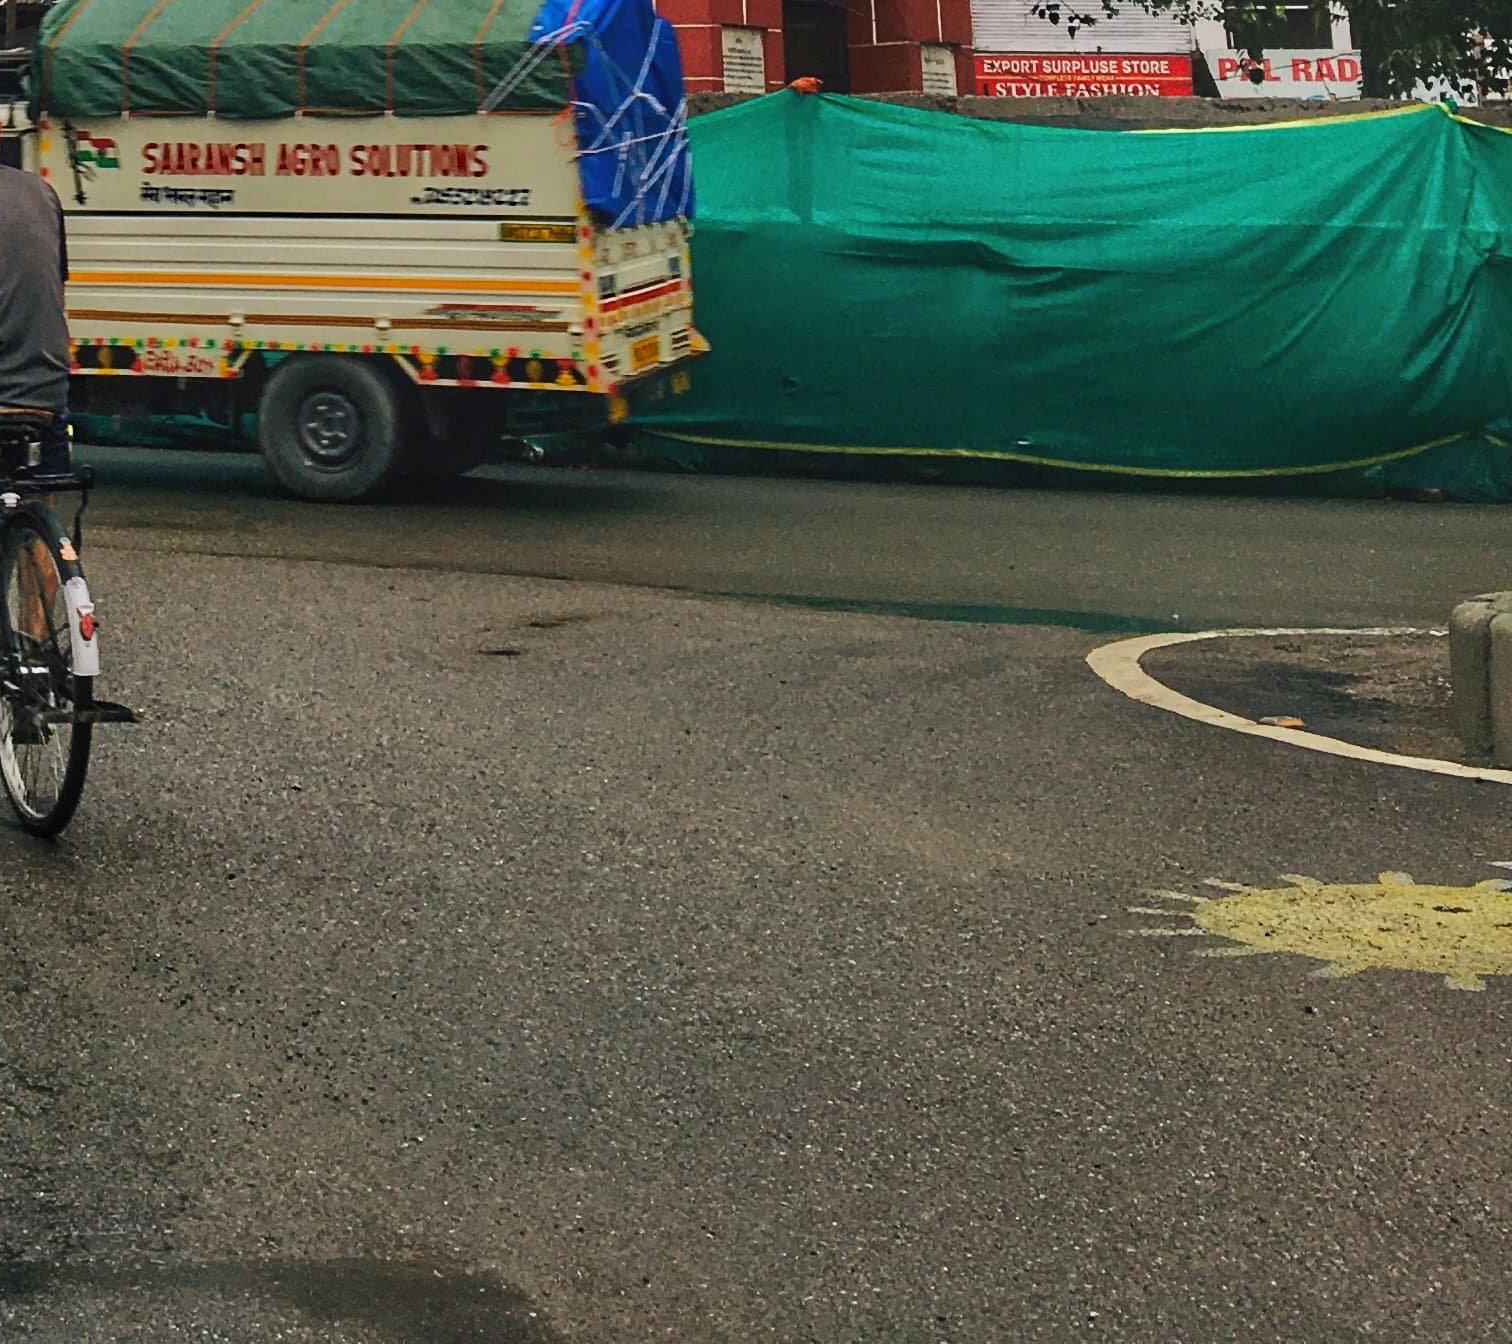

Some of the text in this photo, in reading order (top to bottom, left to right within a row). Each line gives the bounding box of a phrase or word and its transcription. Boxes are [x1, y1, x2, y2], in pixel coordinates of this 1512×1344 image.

[983, 58, 1170, 75] EXPORT SURPLUSE STORE
[995, 83, 1160, 97] STYLE FASHION
[274, 142, 342, 178] AGRO
[349, 143, 490, 178] SOLUTIONS
